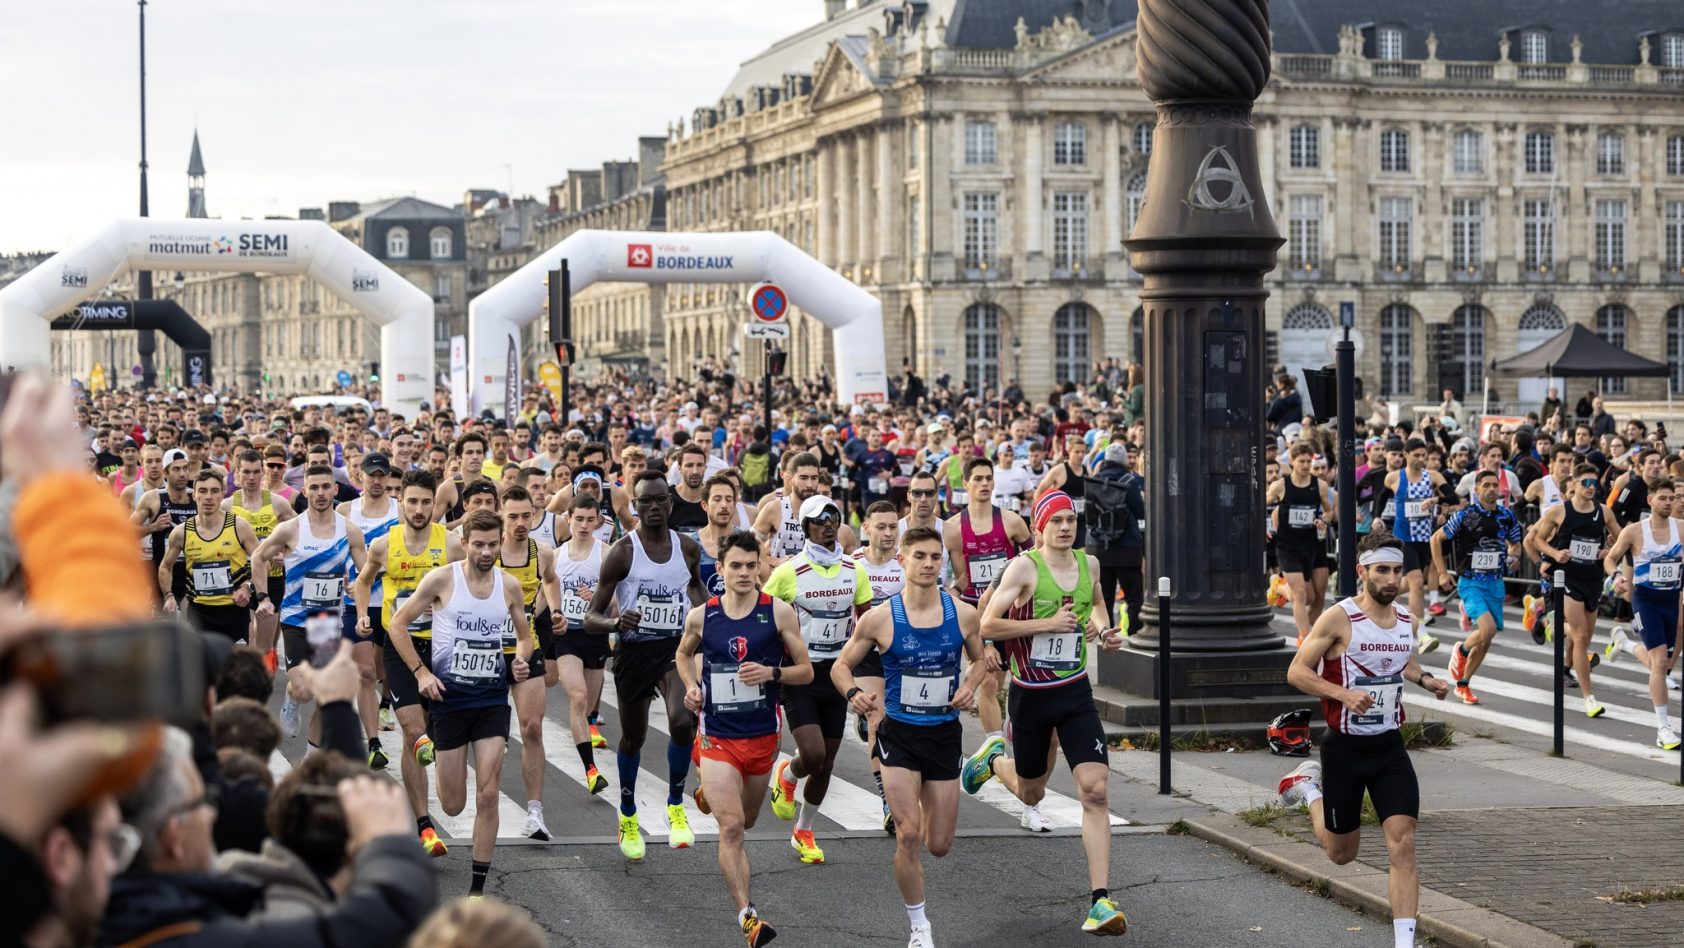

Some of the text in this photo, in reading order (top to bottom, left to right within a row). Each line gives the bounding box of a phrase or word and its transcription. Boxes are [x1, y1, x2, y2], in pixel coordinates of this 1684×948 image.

[149, 242, 211, 254] matmut
[239, 234, 288, 250] SEMI
[656, 244, 676, 252] Ville
[656, 256, 733, 269] BORDEAUX
[61, 275, 88, 286] SEMI
[352, 279, 379, 289] SEMI
[1294, 511, 1309, 522] 142
[1576, 543, 1592, 557] 190
[1478, 554, 1494, 566] 239
[980, 563, 993, 578] 21
[1657, 566, 1673, 578] 188
[202, 572, 215, 585] 71
[315, 583, 328, 597] 16
[805, 588, 854, 599] BORDEAUX
[637, 605, 677, 624] 15016
[822, 623, 838, 639] 41
[1048, 637, 1063, 656] 18
[1360, 643, 1410, 652] BORDEAUX
[453, 652, 495, 671] 15015
[729, 678, 736, 697] 1
[919, 682, 929, 700] 4
